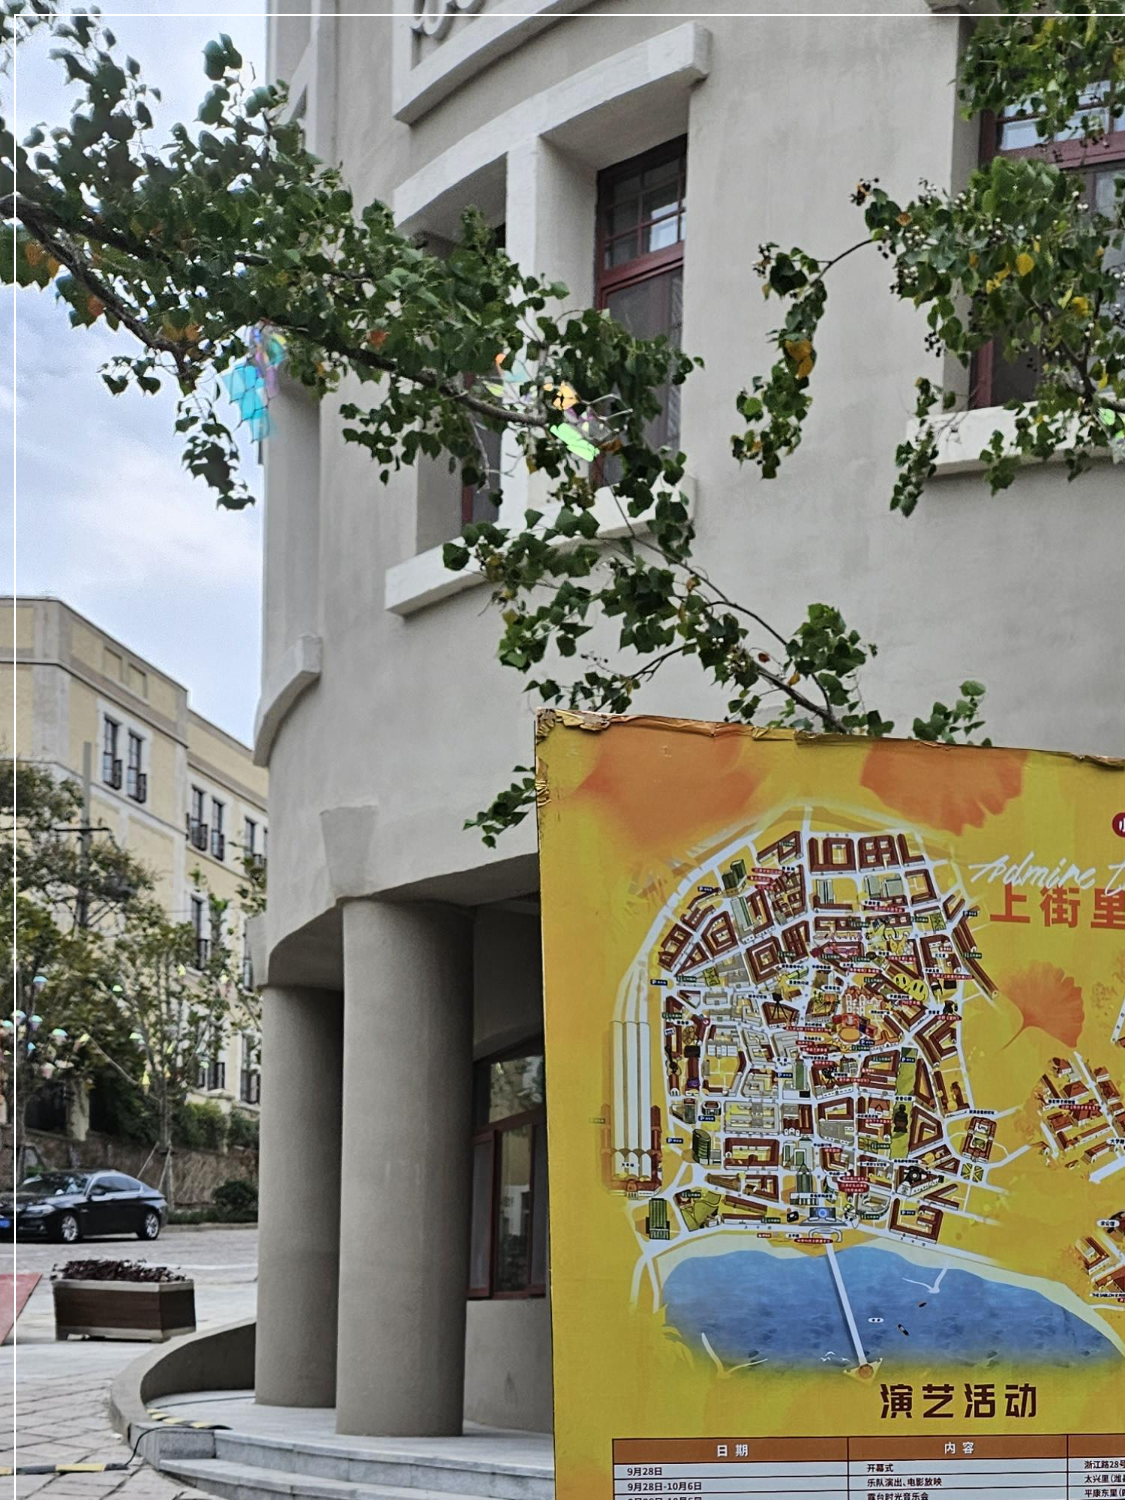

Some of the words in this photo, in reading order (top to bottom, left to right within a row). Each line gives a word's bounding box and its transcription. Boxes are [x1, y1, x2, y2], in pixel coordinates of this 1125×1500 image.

[969, 852, 1096, 887] Admire
[880, 1383, 1037, 1419] 演艺活动
[627, 1467, 662, 1476] 9月28日
[867, 1463, 893, 1472] 开幕式
[628, 1482, 701, 1491] 9月28日-10月6日
